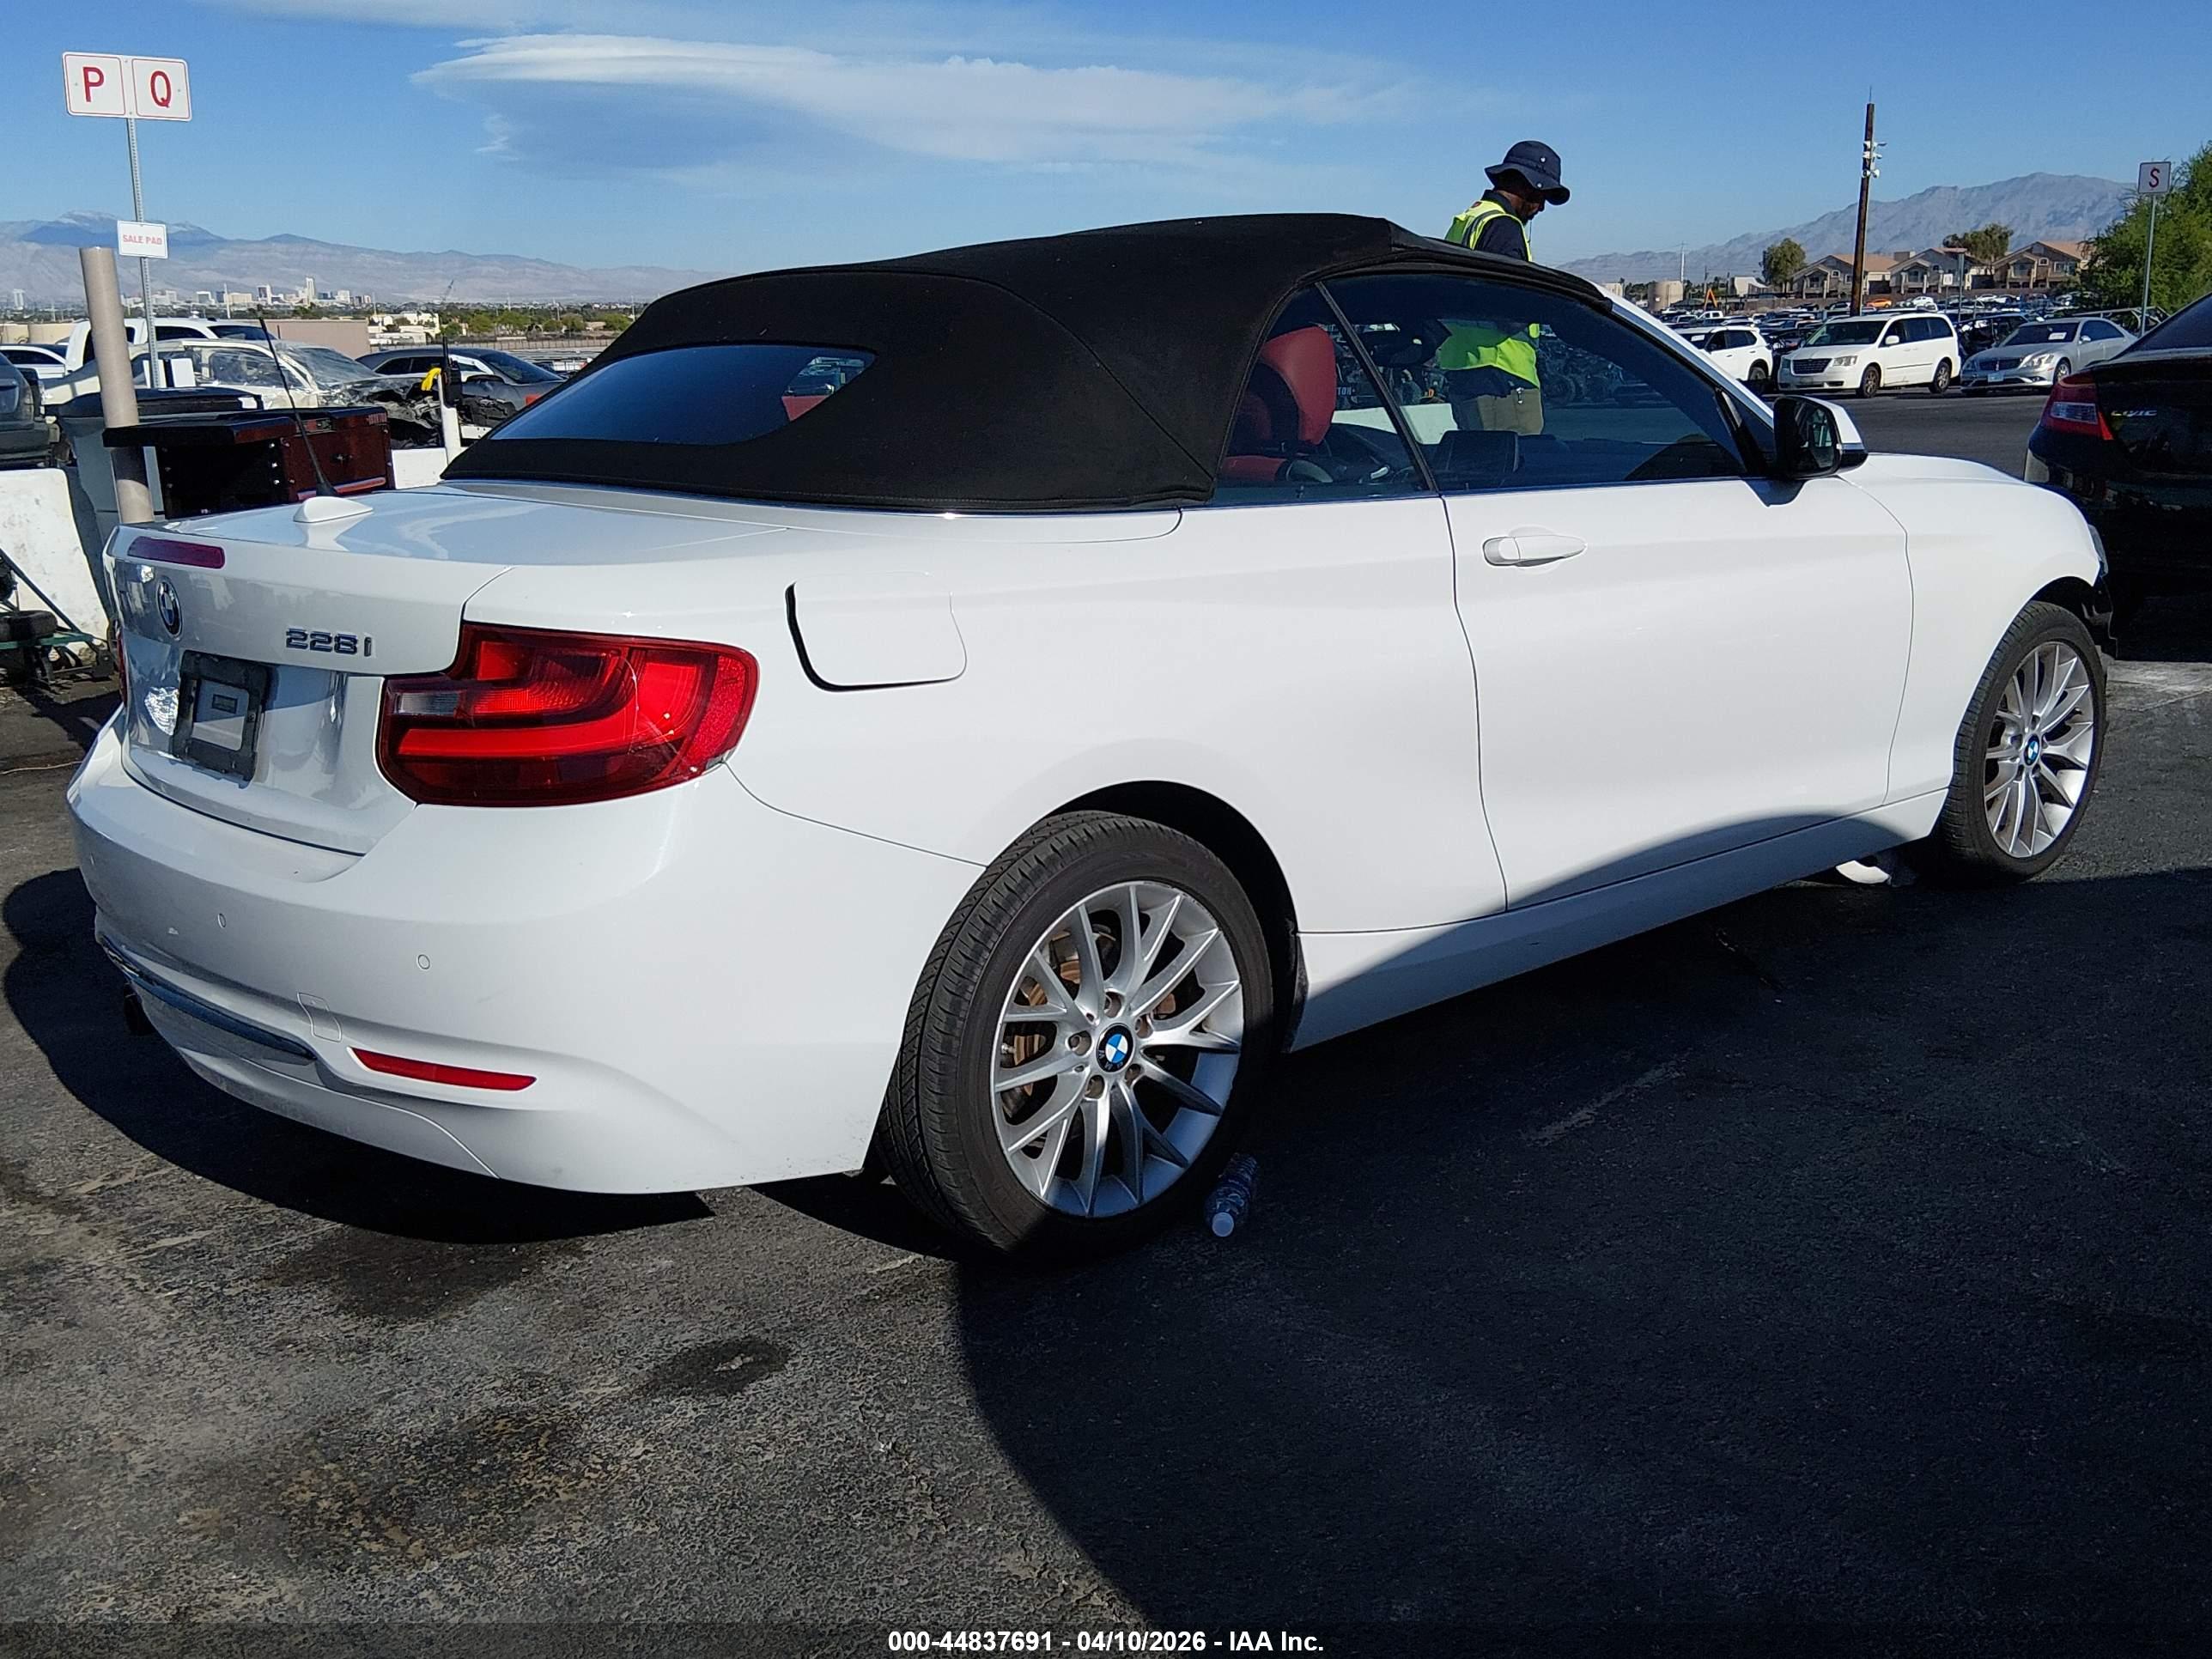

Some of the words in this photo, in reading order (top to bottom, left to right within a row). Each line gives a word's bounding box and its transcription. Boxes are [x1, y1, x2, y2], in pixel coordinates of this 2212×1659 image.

[82, 66, 105, 102] P
[149, 70, 172, 108] Q
[2148, 167, 2160, 188] S
[123, 234, 144, 244] SALE
[145, 236, 163, 246] PAD
